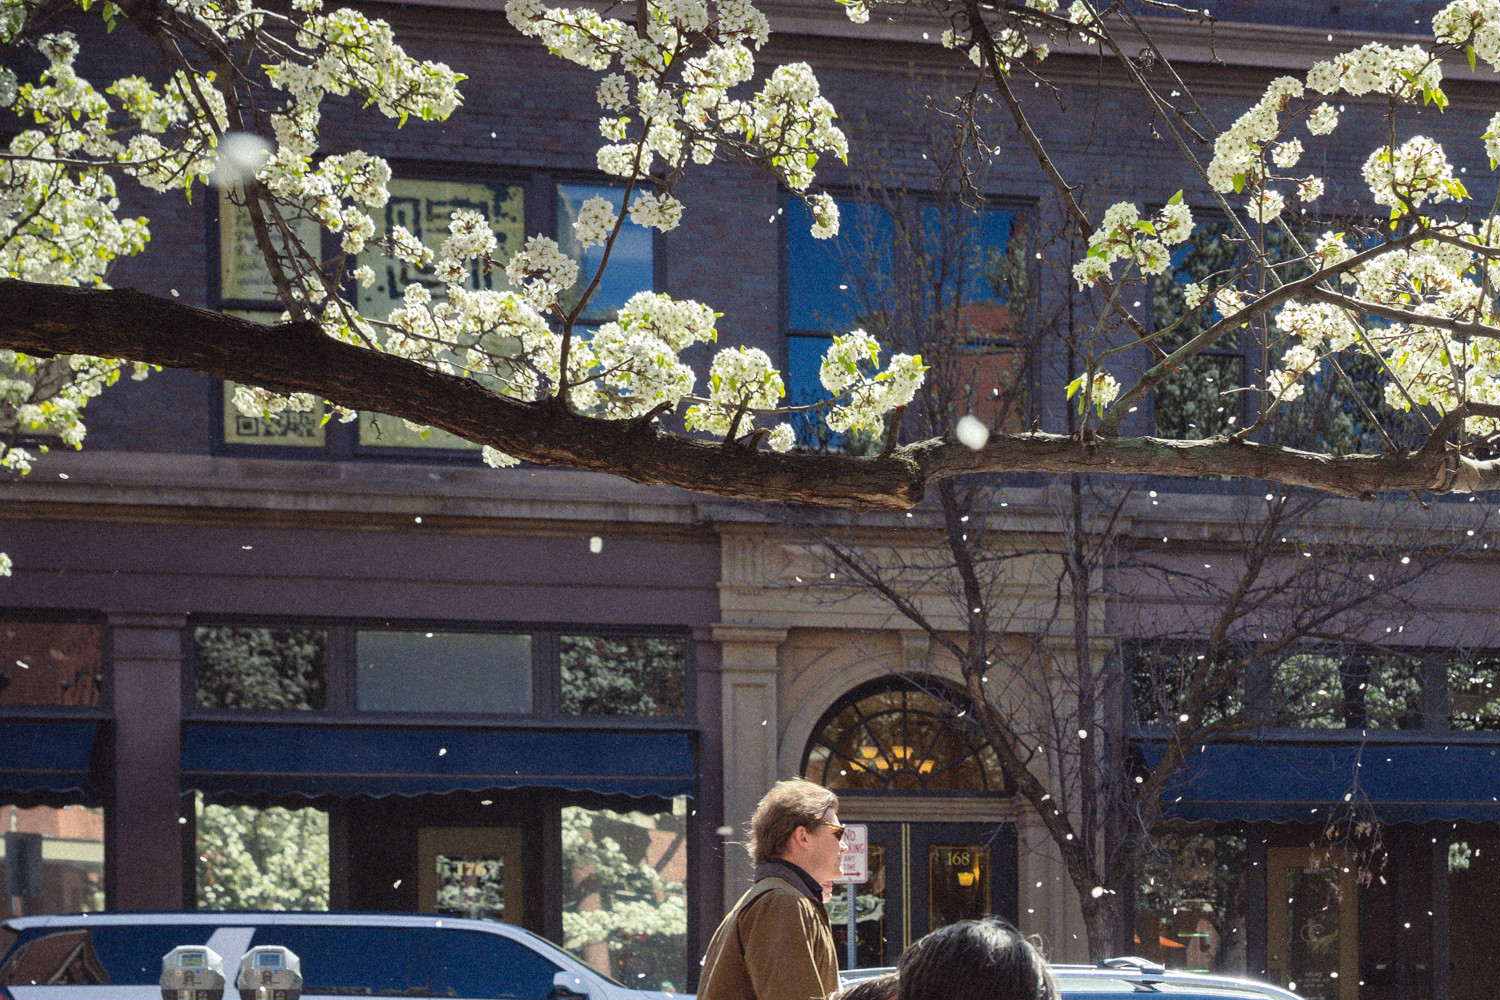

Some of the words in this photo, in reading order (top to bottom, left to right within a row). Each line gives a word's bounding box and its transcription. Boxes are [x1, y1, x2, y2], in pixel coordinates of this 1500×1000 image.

[843, 830, 856, 842] NO
[947, 852, 970, 866] 168
[456, 862, 488, 877] 176
